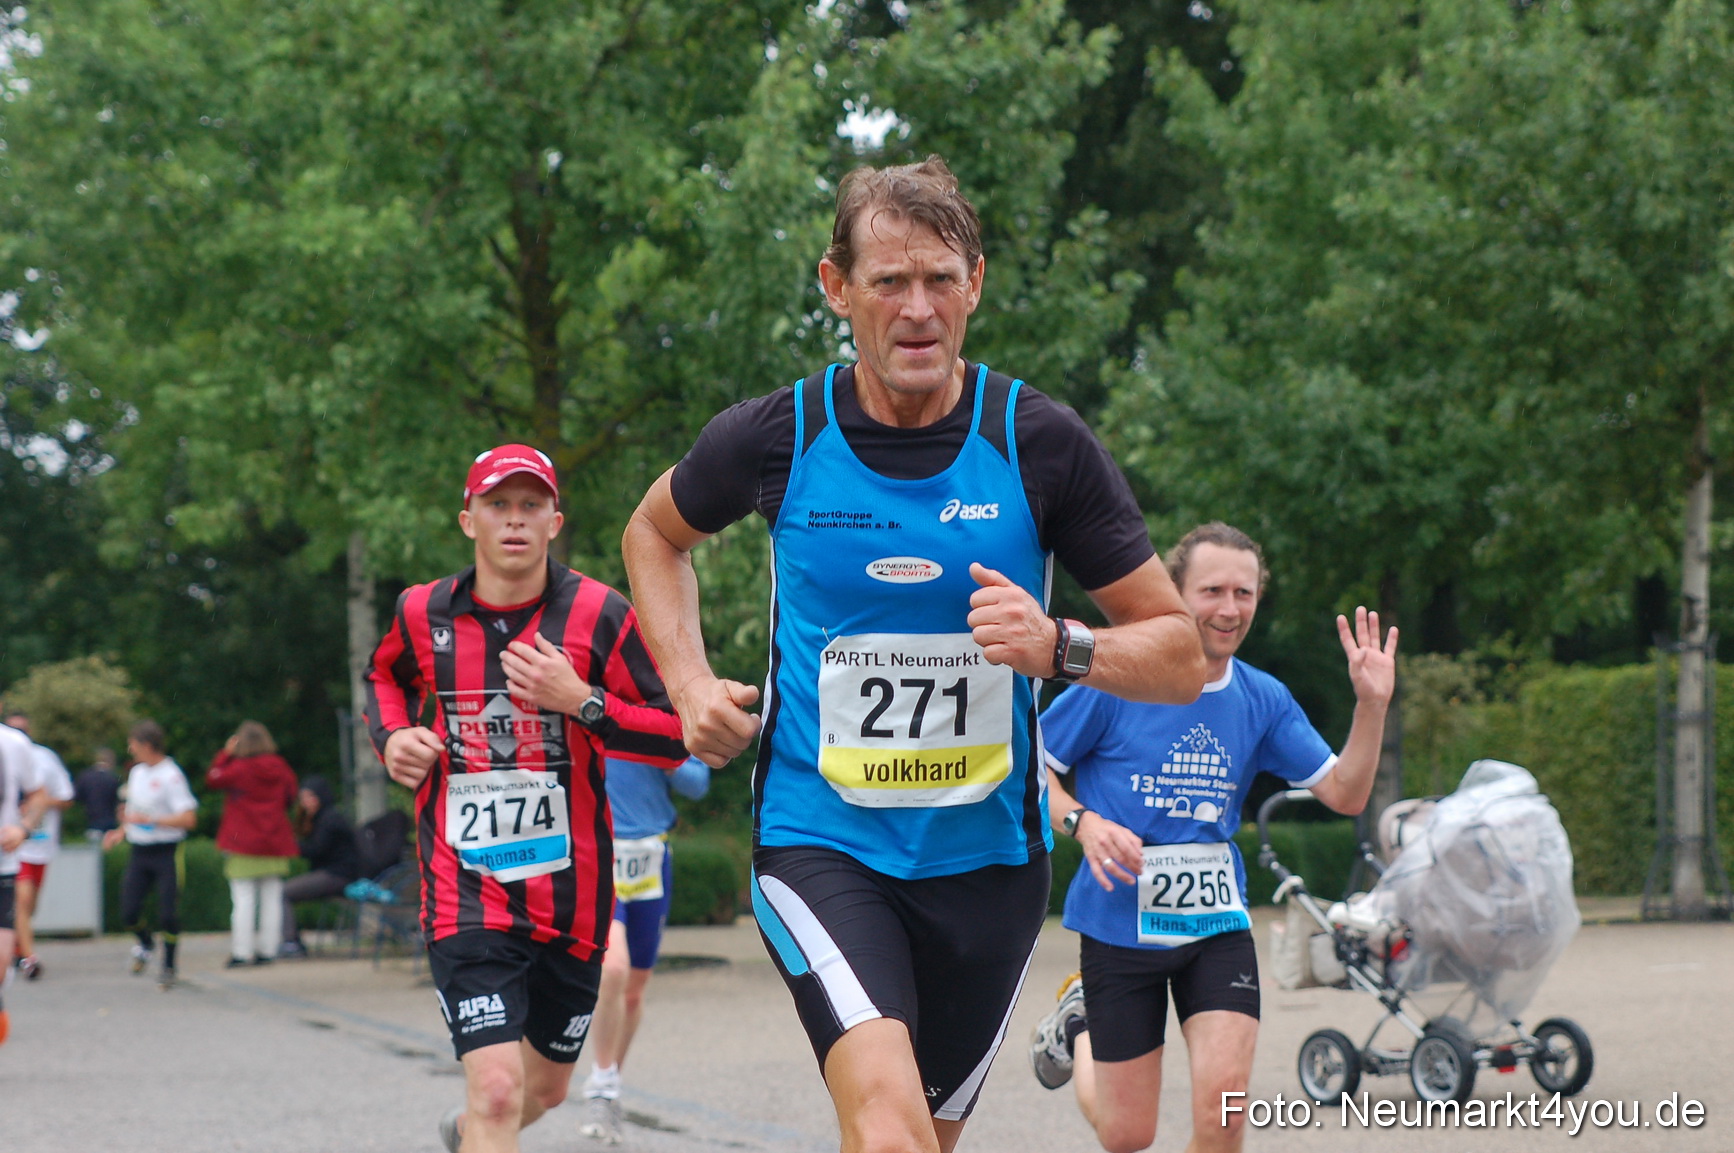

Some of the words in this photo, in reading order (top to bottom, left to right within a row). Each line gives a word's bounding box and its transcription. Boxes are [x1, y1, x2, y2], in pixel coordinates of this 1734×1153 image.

[807, 520, 872, 529] Neunkirchen
[888, 521, 903, 529] Br.
[808, 510, 873, 520] SportGruppe
[825, 651, 885, 667] PARTL
[891, 651, 980, 667] Neumarkt
[860, 676, 969, 739] 271
[459, 714, 553, 736] PLATZER
[863, 756, 968, 782] volkhard
[448, 785, 485, 797] PARTL
[487, 780, 540, 792] Neumarkt
[1130, 774, 1161, 794] 13.
[460, 795, 556, 842] 2174
[1152, 869, 1231, 908] 2256
[563, 1014, 592, 1038] 18
